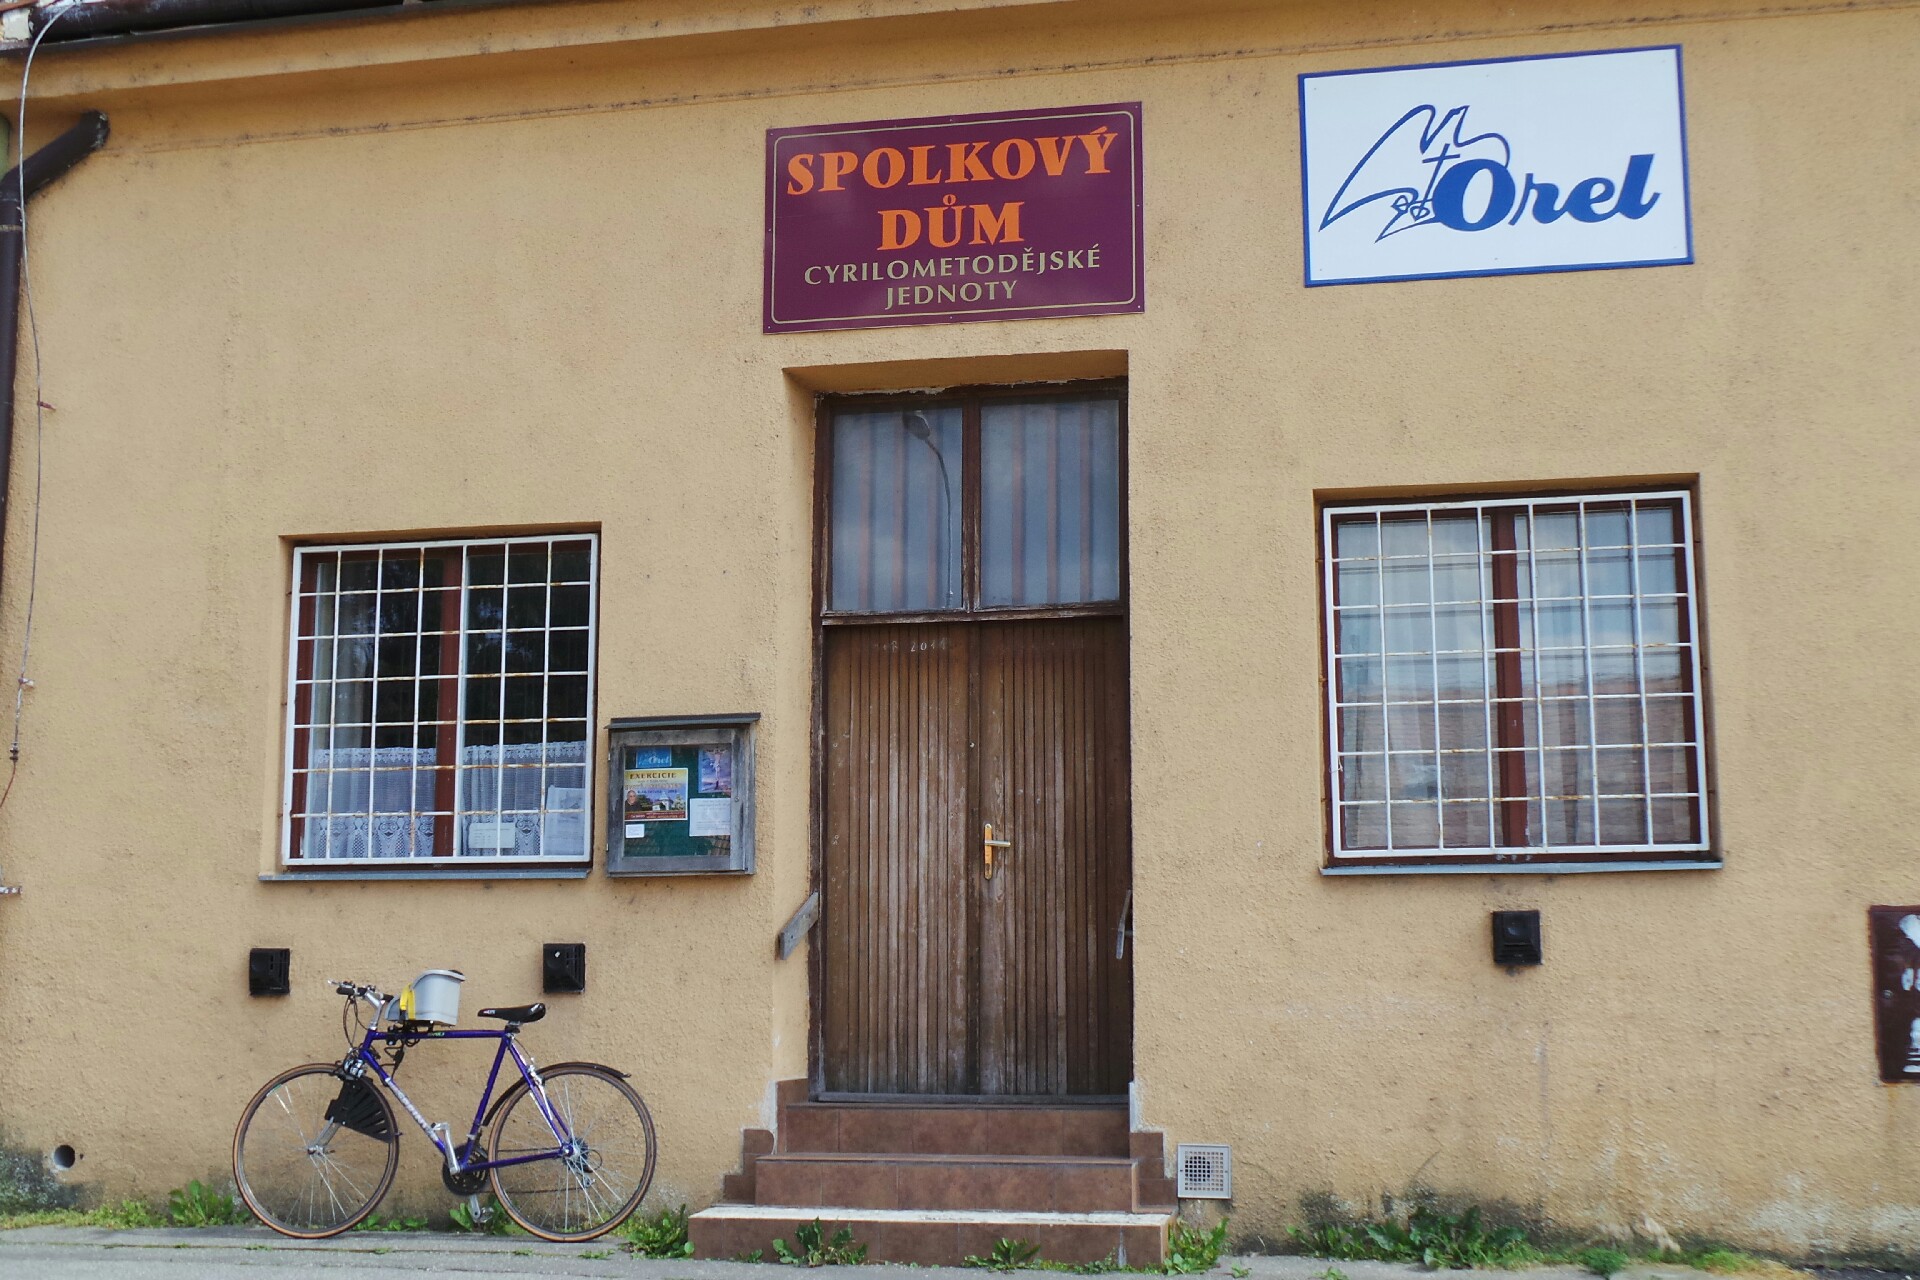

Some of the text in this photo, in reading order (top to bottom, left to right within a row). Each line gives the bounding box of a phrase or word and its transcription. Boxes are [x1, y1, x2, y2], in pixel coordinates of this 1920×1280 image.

[787, 126, 1118, 196] SPOLKOVÝ
[1432, 153, 1660, 232] Orel
[877, 194, 1025, 251] DŮM
[804, 243, 1101, 286] CYRILOMETODĚJSKÉ
[884, 280, 1018, 310] JEDNOTY
